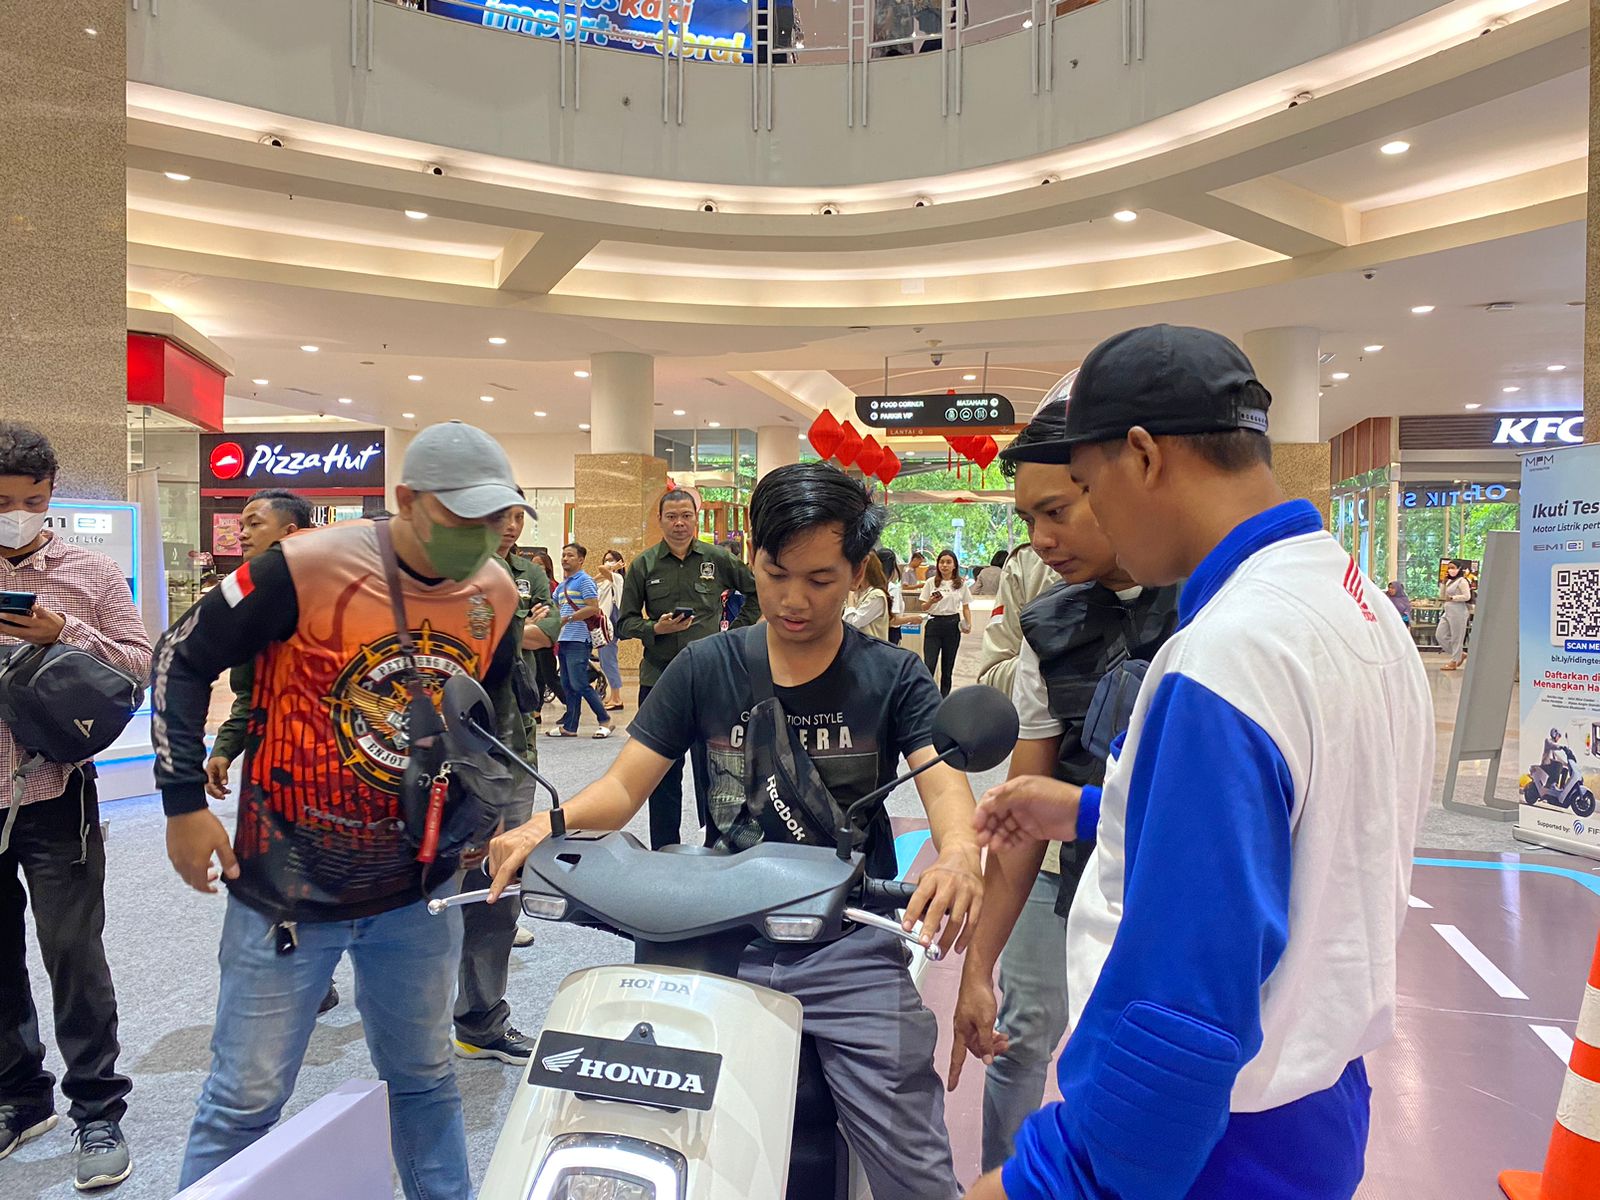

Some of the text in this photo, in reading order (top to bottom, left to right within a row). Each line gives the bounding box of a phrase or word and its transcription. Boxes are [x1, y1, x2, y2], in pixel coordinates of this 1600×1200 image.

[956, 399, 988, 407] MATAHARI
[880, 412, 902, 420] PARKIR
[1493, 416, 1584, 444] KFC
[1532, 499, 1600, 518] Ikuti Tes
[1532, 525, 1556, 533] Motor
[1557, 522, 1581, 532] Listrik
[68, 535, 79, 543] of
[1566, 642, 1600, 651] SCAN ME
[1545, 671, 1589, 681] Daftarkan
[1533, 680, 1585, 692] Menangkan
[813, 712, 844, 725] STYLE
[731, 725, 853, 751] CERA
[367, 742, 405, 767] ENJOY
[766, 774, 806, 842] Reebok
[1537, 820, 1562, 831] Supported
[576, 1057, 705, 1094] HONDA
